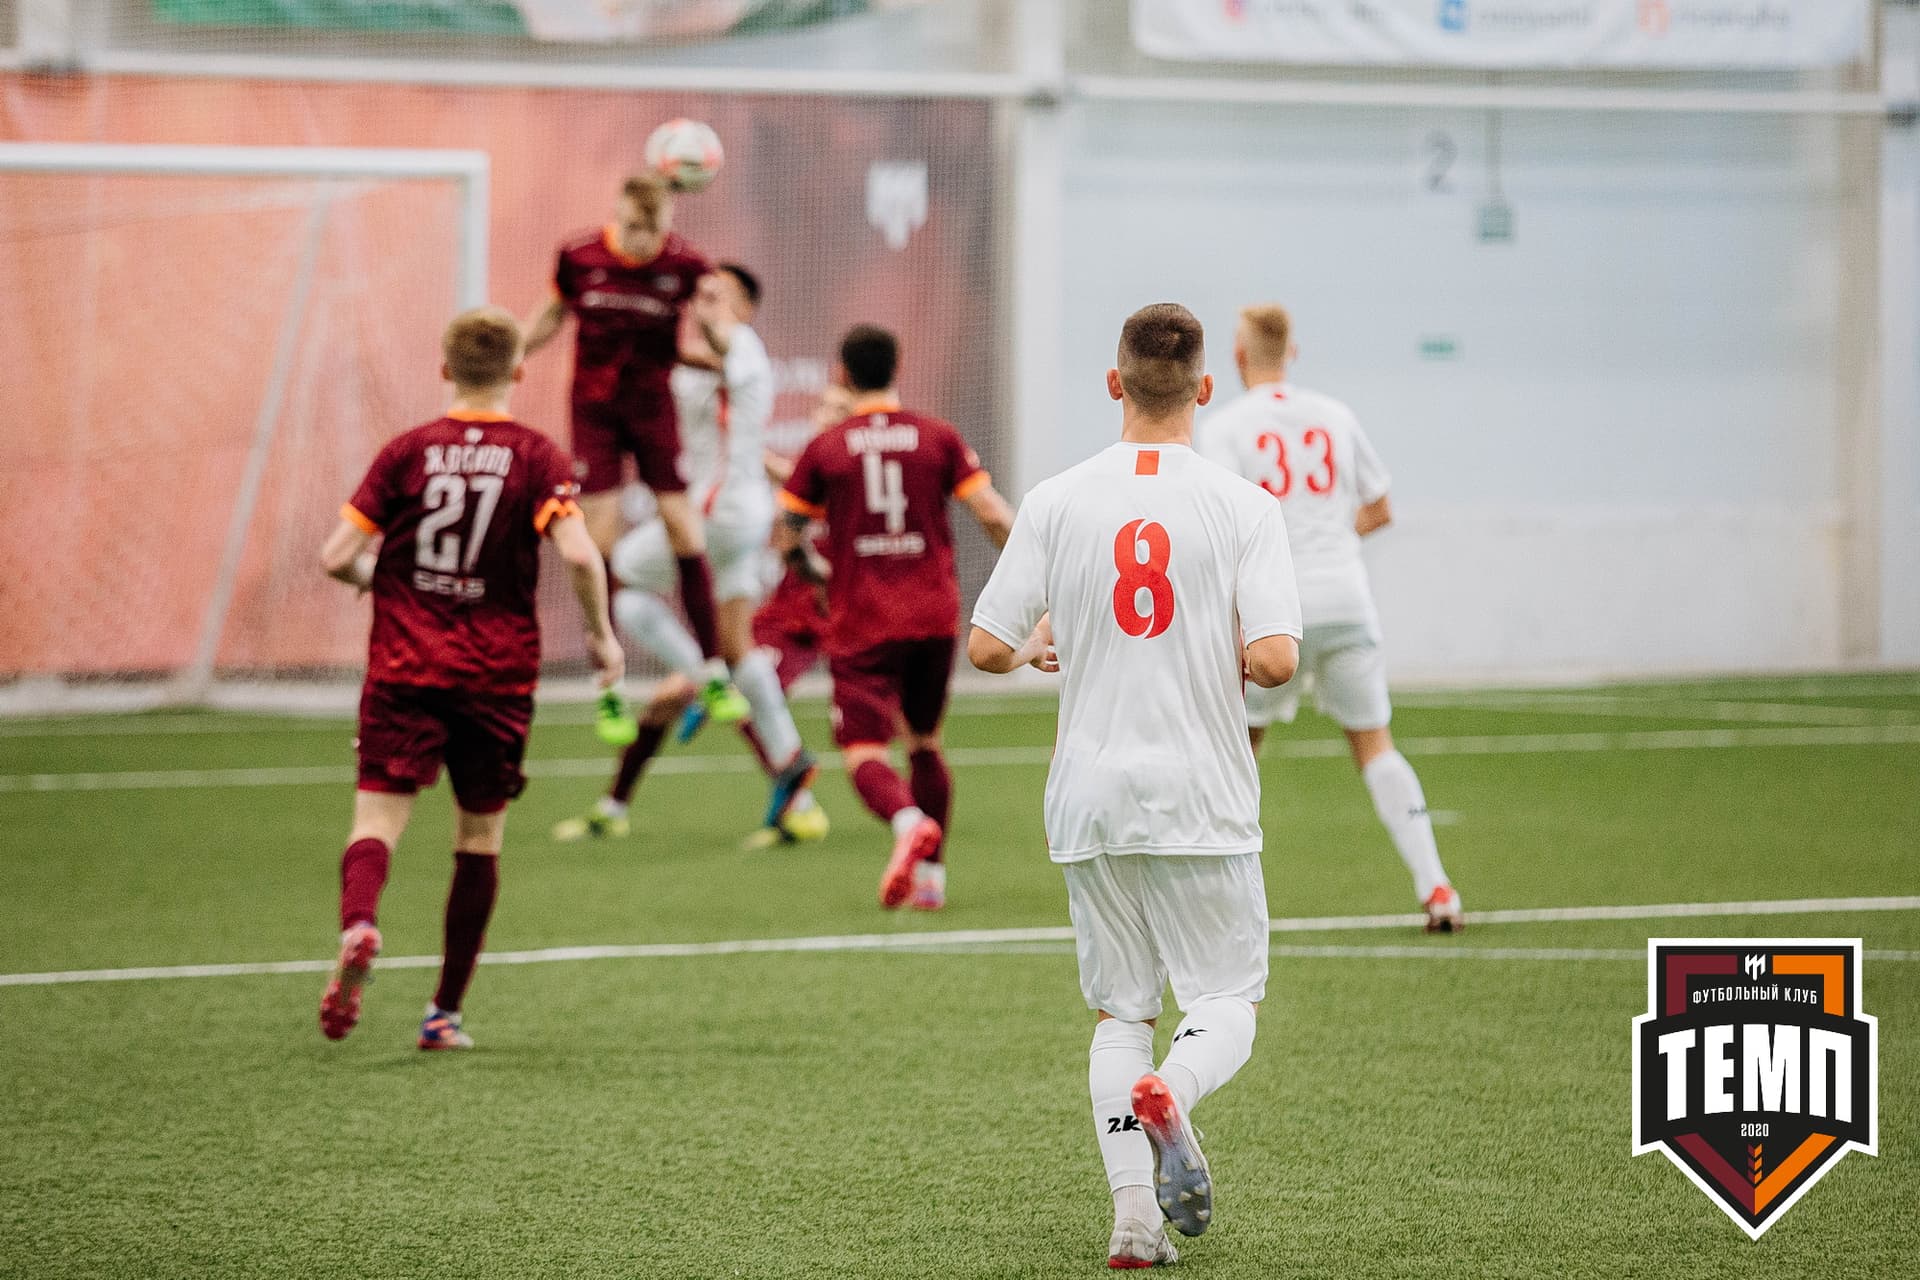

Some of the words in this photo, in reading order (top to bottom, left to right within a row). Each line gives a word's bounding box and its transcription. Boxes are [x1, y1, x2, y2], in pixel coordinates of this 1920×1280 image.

[862, 449, 909, 535] 4
[1256, 427, 1337, 498] 33
[415, 473, 505, 574] 27
[1112, 518, 1176, 639] 8
